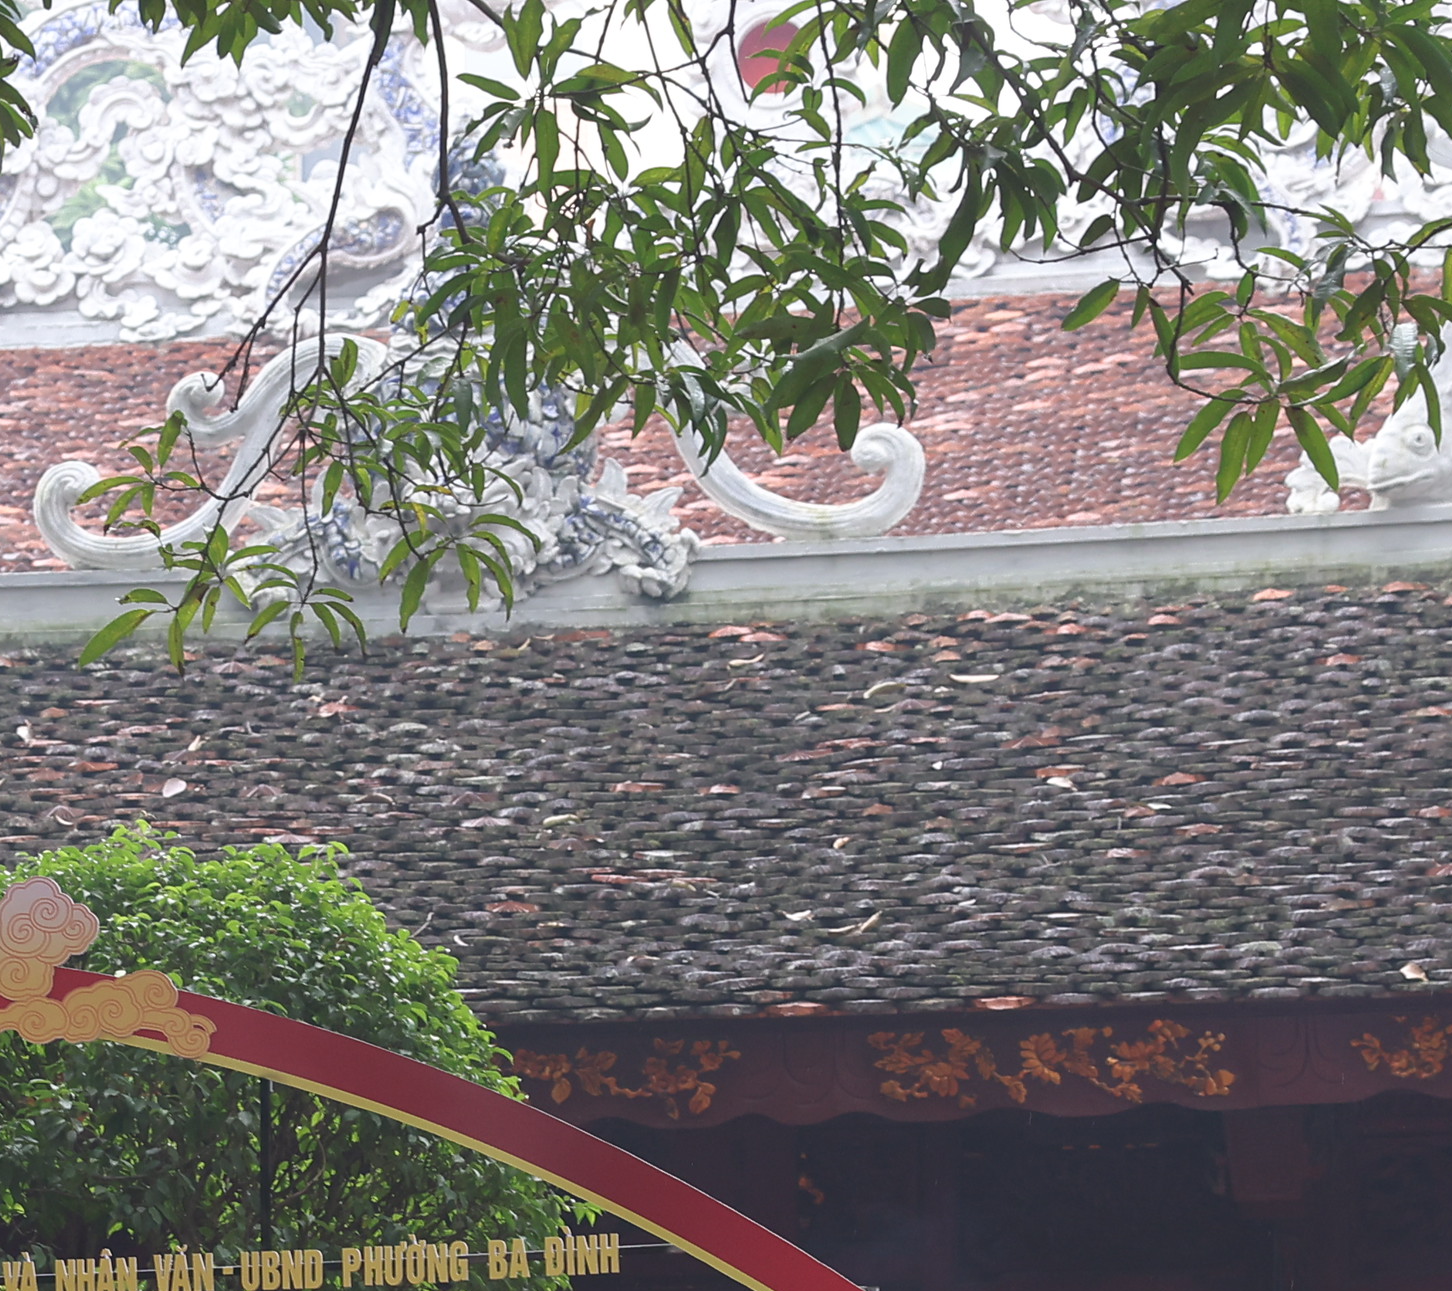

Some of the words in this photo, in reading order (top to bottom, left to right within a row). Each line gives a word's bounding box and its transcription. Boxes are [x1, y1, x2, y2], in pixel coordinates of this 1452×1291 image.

[342, 1235, 469, 1287] PHƯỜNG
[488, 1239, 531, 1280] BA
[544, 1226, 620, 1277] ĐÌNH
